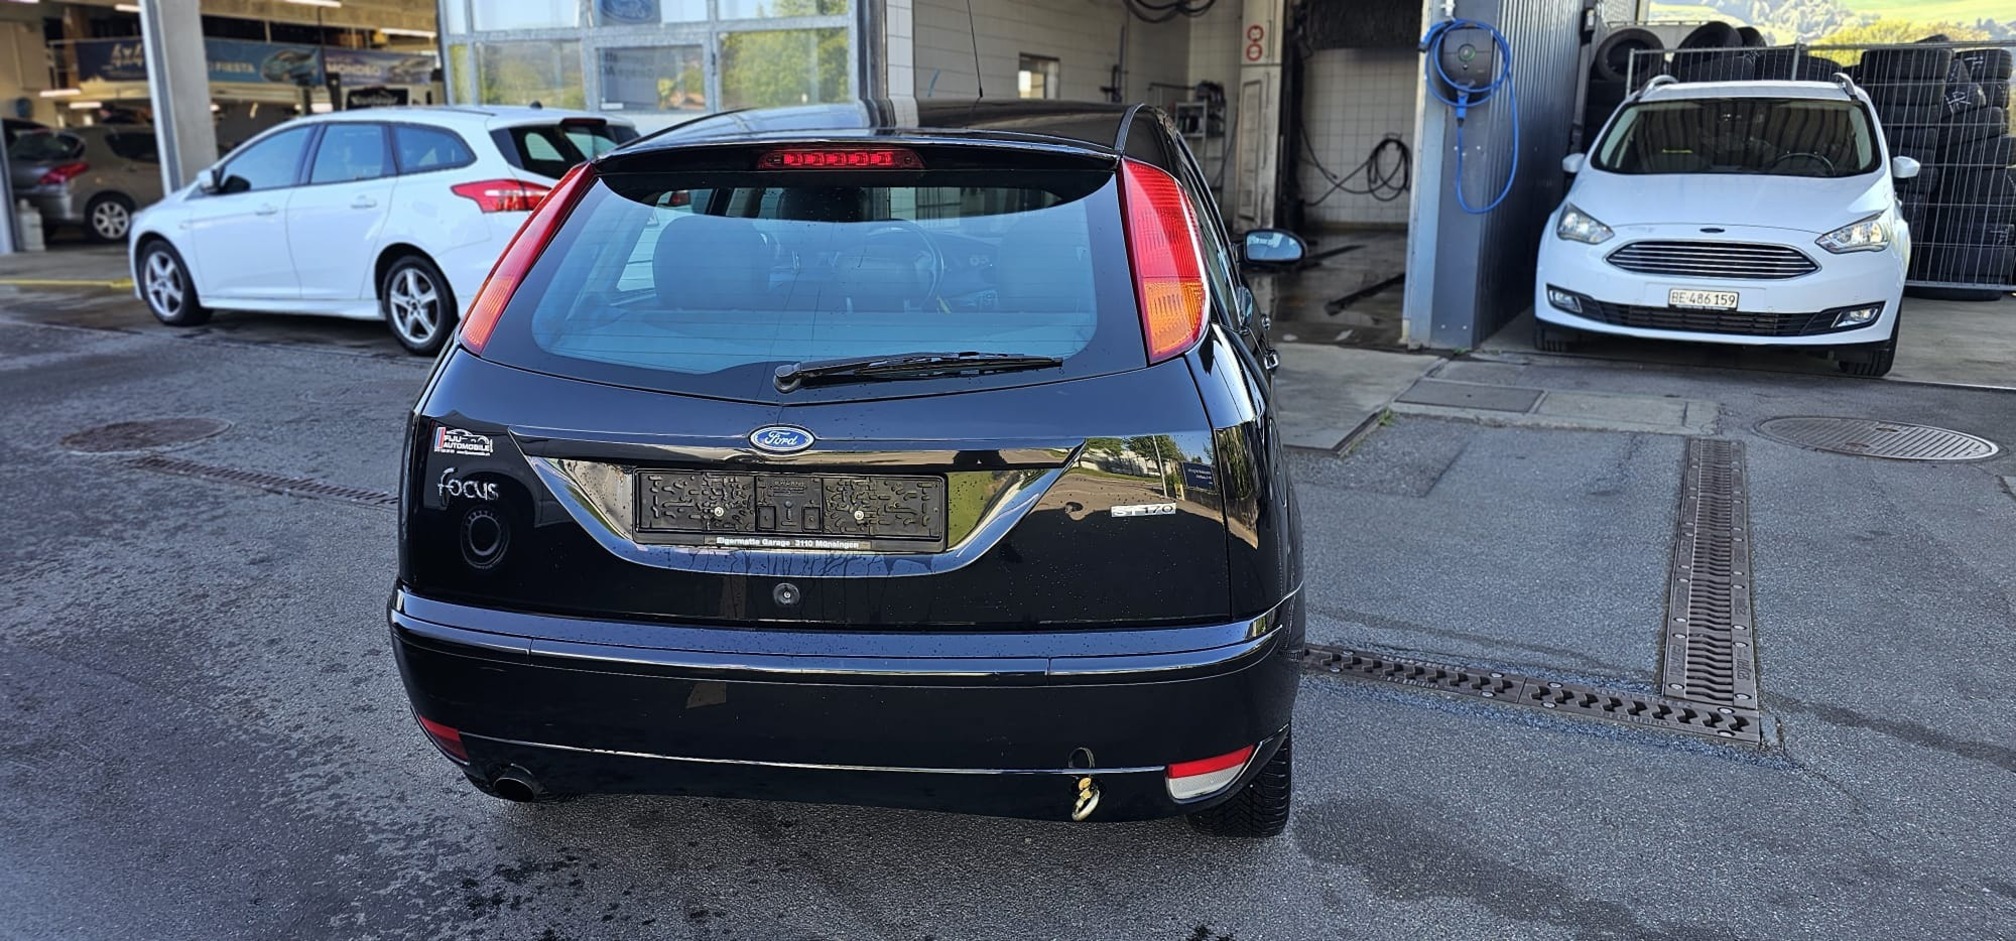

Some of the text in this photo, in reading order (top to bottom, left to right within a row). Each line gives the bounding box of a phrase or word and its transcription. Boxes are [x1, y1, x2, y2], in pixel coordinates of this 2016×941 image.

[215, 61, 256, 74] FIESTA
[764, 430, 798, 445] Ford
[716, 537, 760, 546] Eigermatte
[762, 539, 790, 547] Garage
[815, 540, 859, 549] Münsingen
